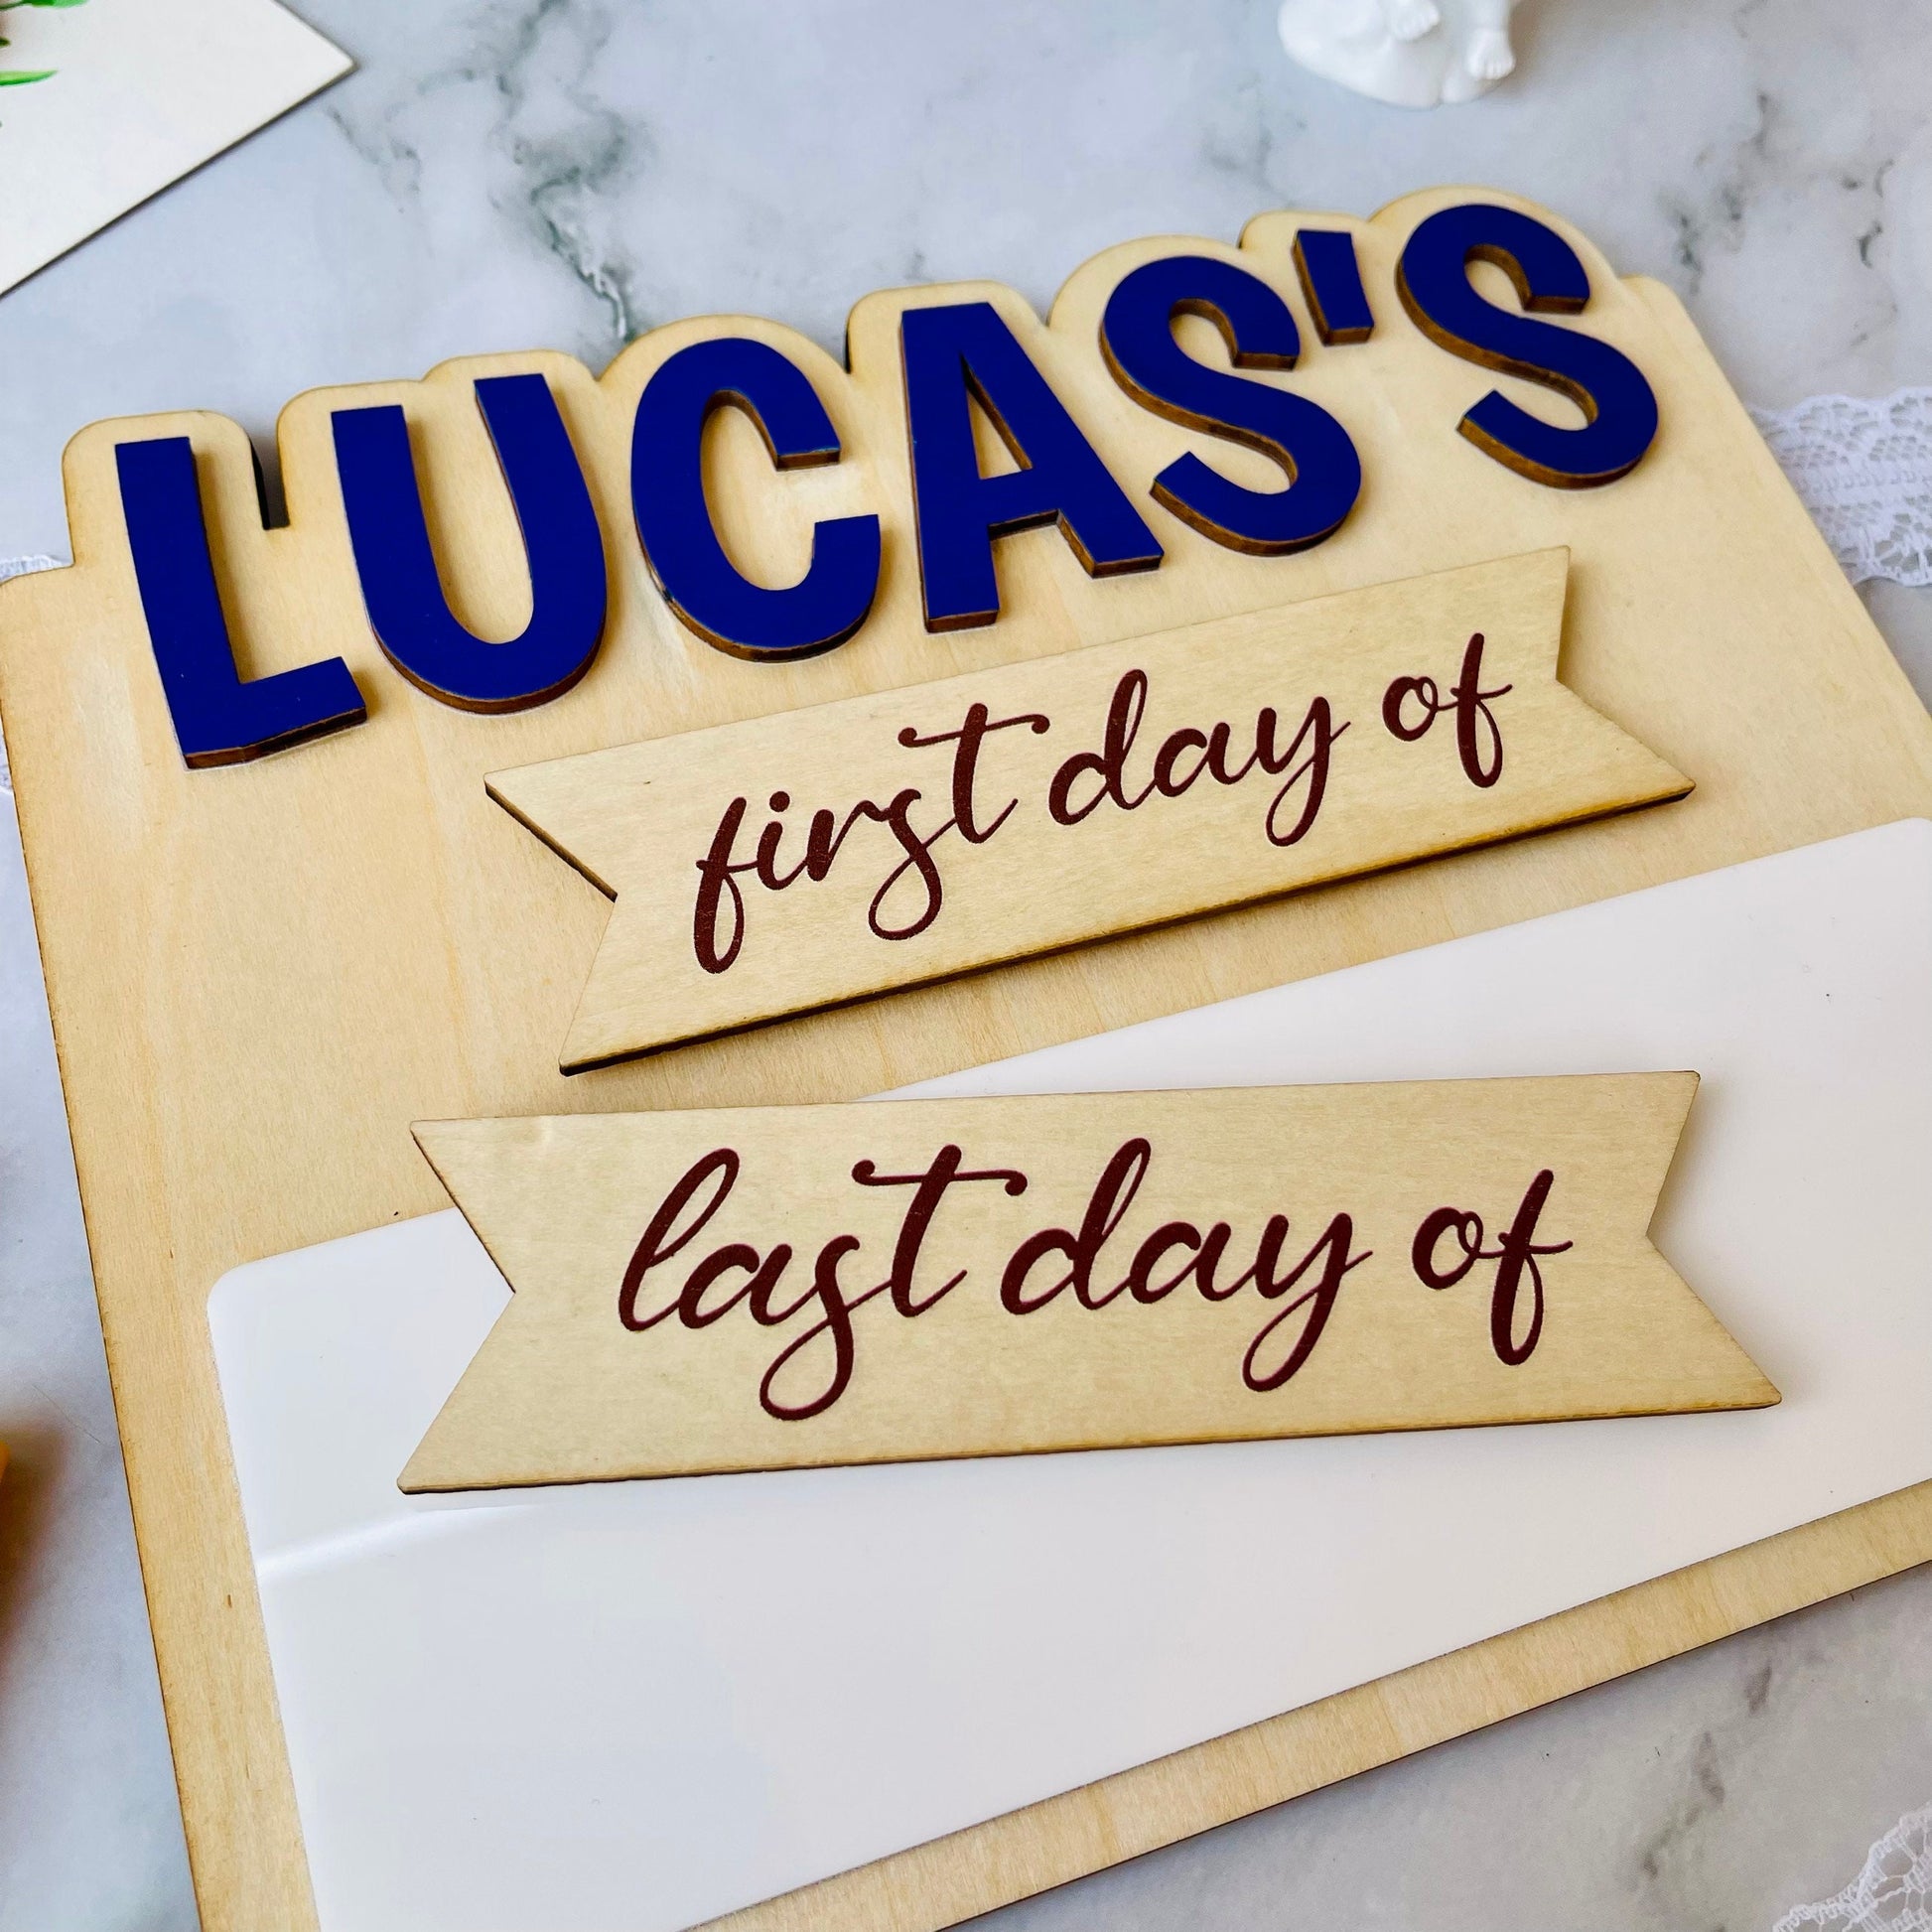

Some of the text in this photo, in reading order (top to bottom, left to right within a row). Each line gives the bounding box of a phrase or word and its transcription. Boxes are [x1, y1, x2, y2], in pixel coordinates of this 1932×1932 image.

[115, 205, 1658, 767] LUCAS'S
[693, 632, 1513, 975] first day of
[618, 1138, 1574, 1422] last day of
